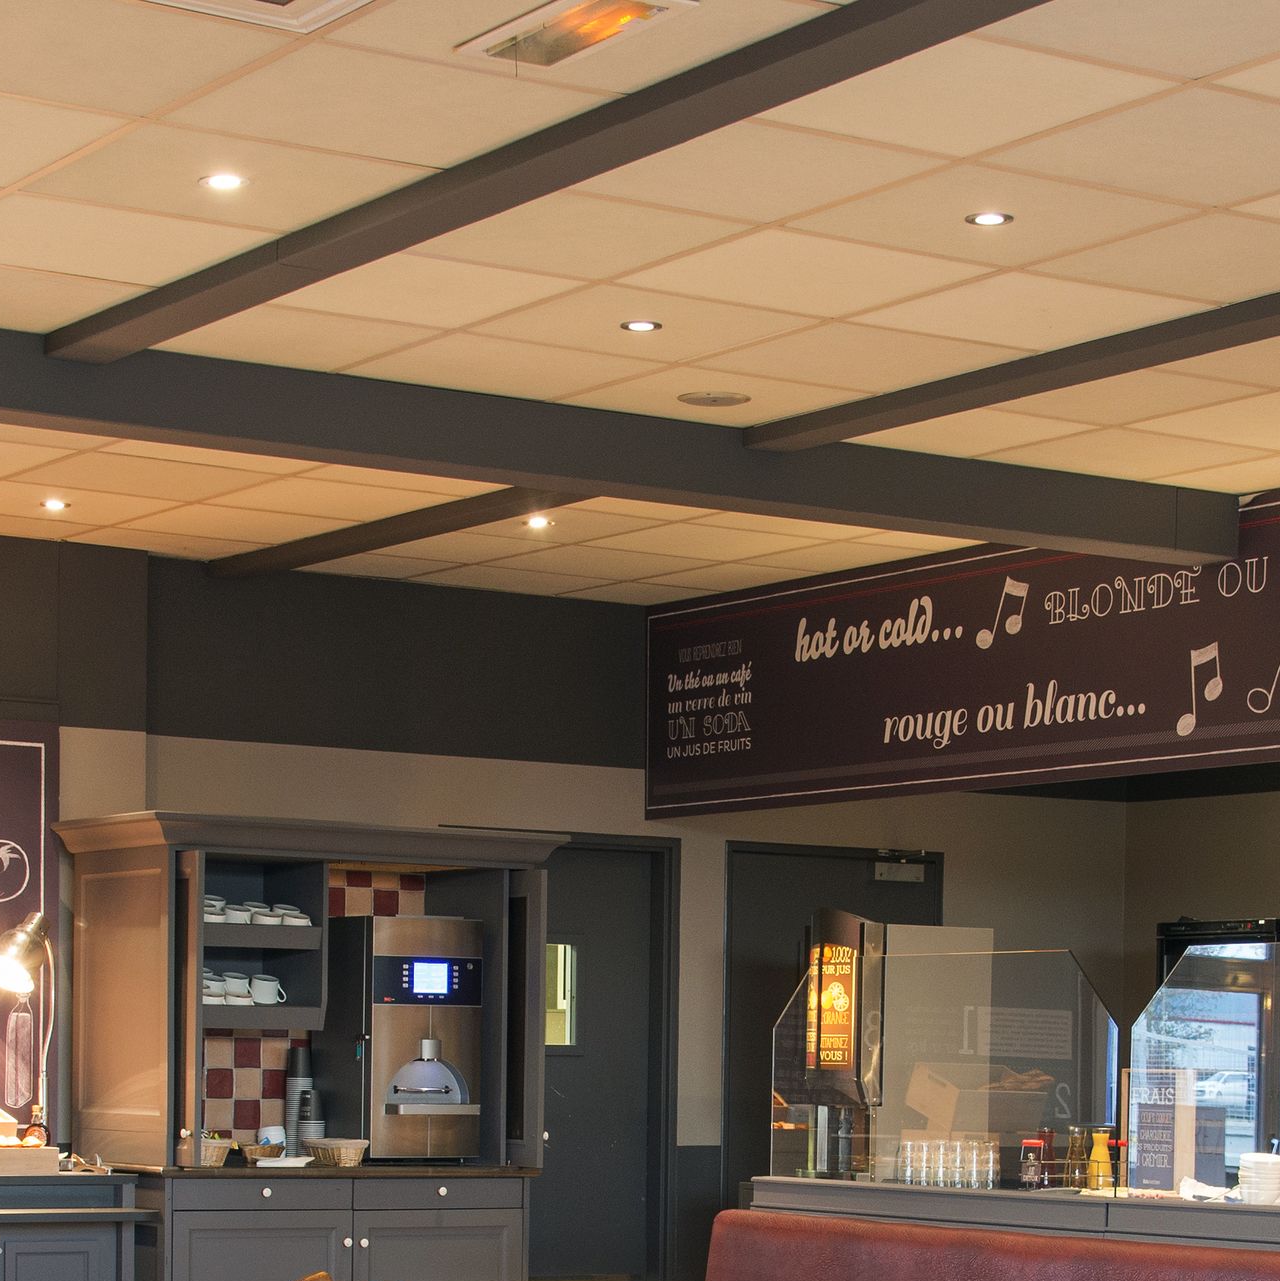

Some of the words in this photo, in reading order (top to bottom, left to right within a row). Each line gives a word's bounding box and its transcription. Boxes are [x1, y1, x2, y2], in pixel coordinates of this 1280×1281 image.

[1044, 562, 1202, 626] BLONDE
[1217, 556, 1269, 597] OU
[794, 618, 839, 663] hot
[844, 628, 874, 652] or
[878, 595, 963, 650] cold...
[667, 674, 683, 693] Un
[684, 669, 701, 690] thé
[701, 673, 715, 687] ou
[716, 672, 730, 685] un
[731, 661, 752, 687] café
[668, 702, 682, 714] un
[685, 697, 716, 712] verre
[718, 688, 732, 707] de
[734, 686, 752, 705] vin
[883, 706, 968, 749] rouge
[976, 699, 1015, 733] ou
[1023, 680, 1146, 729] blanc...
[668, 716, 695, 741] UN
[703, 711, 751, 736] SODA
[667, 746, 680, 759] UN
[683, 744, 701, 757] JUS
[703, 742, 716, 754] DE
[718, 738, 751, 752] FRUITS
[835, 965, 851, 976] JUS
[820, 1051, 843, 1061] VOUS
[1132, 1087, 1174, 1105] FRAIS
